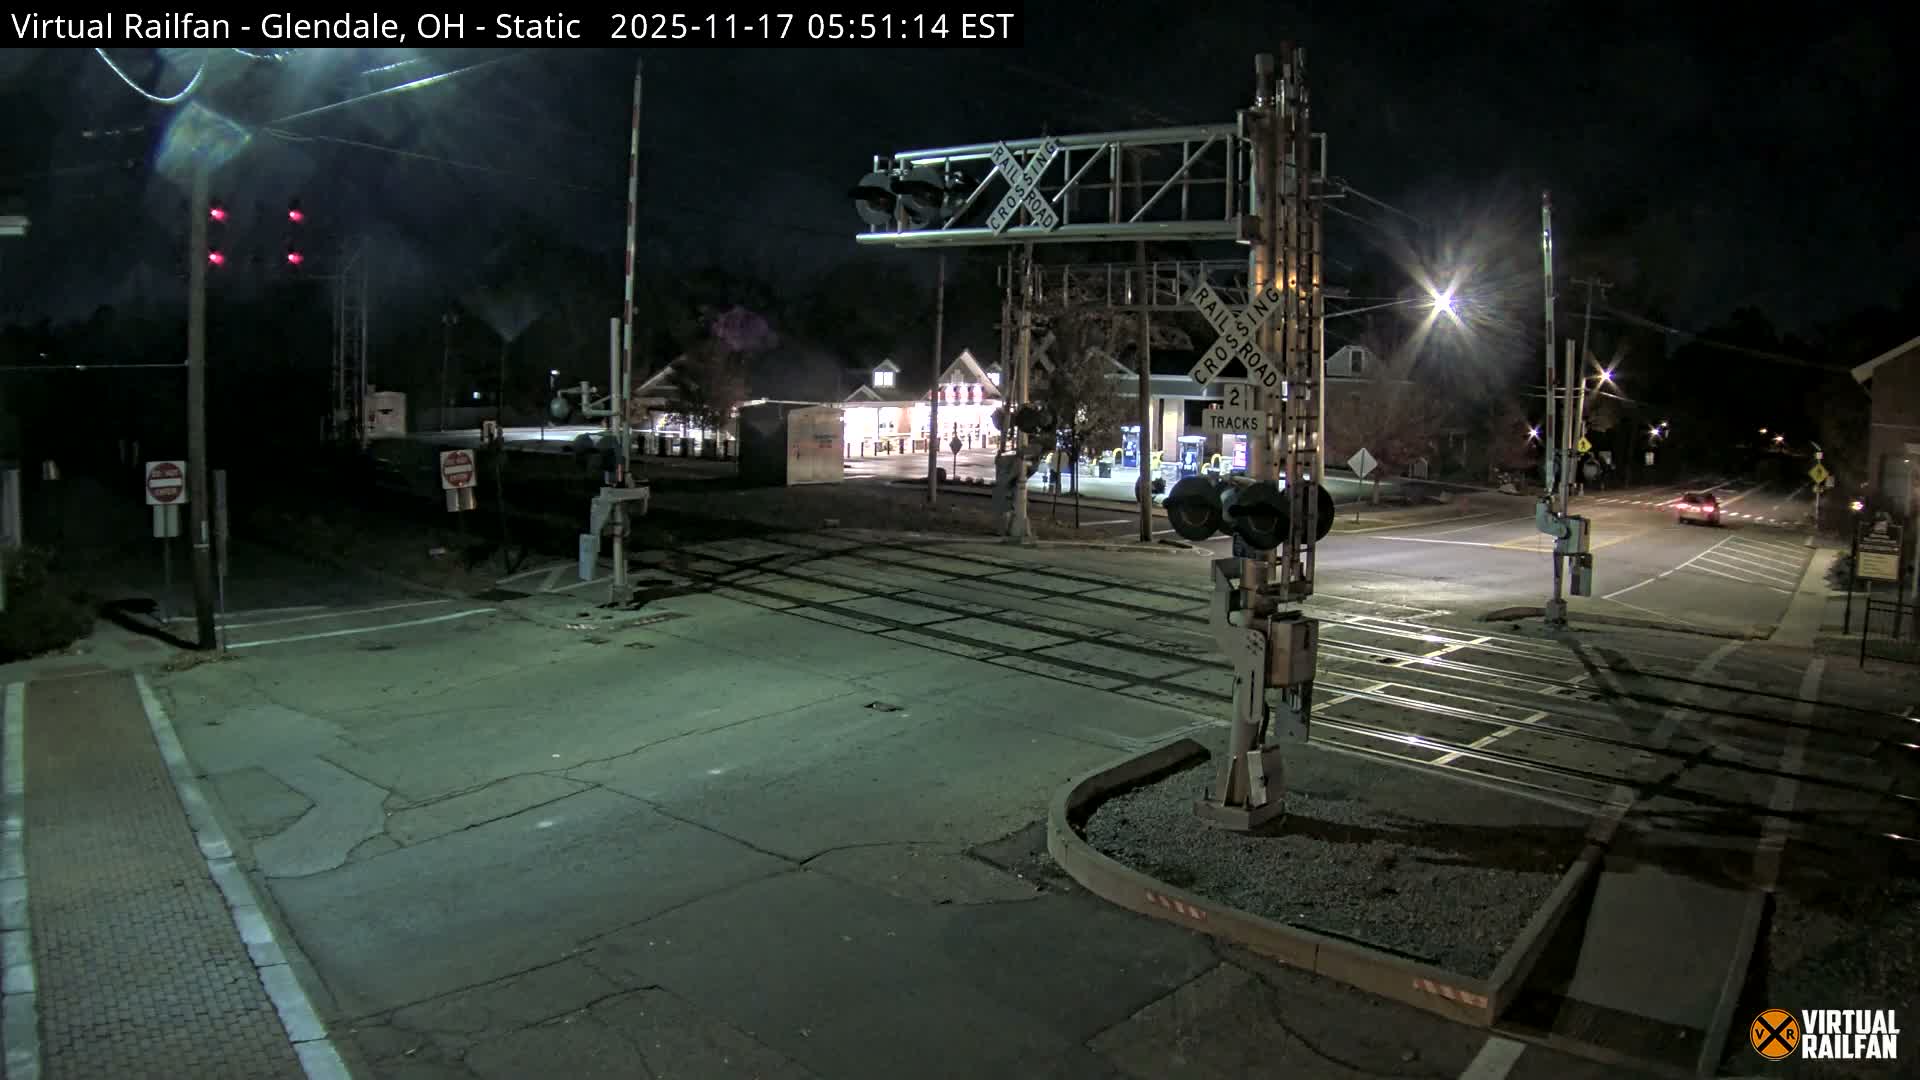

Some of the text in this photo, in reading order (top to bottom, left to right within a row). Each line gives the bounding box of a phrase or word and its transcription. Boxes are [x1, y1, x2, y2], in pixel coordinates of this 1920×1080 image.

[990, 141, 1057, 230] CROSSING
[1194, 287, 1279, 385] CROSSING
[1210, 415, 1258, 431] TRACKS
[1229, 388, 1240, 406] 2
